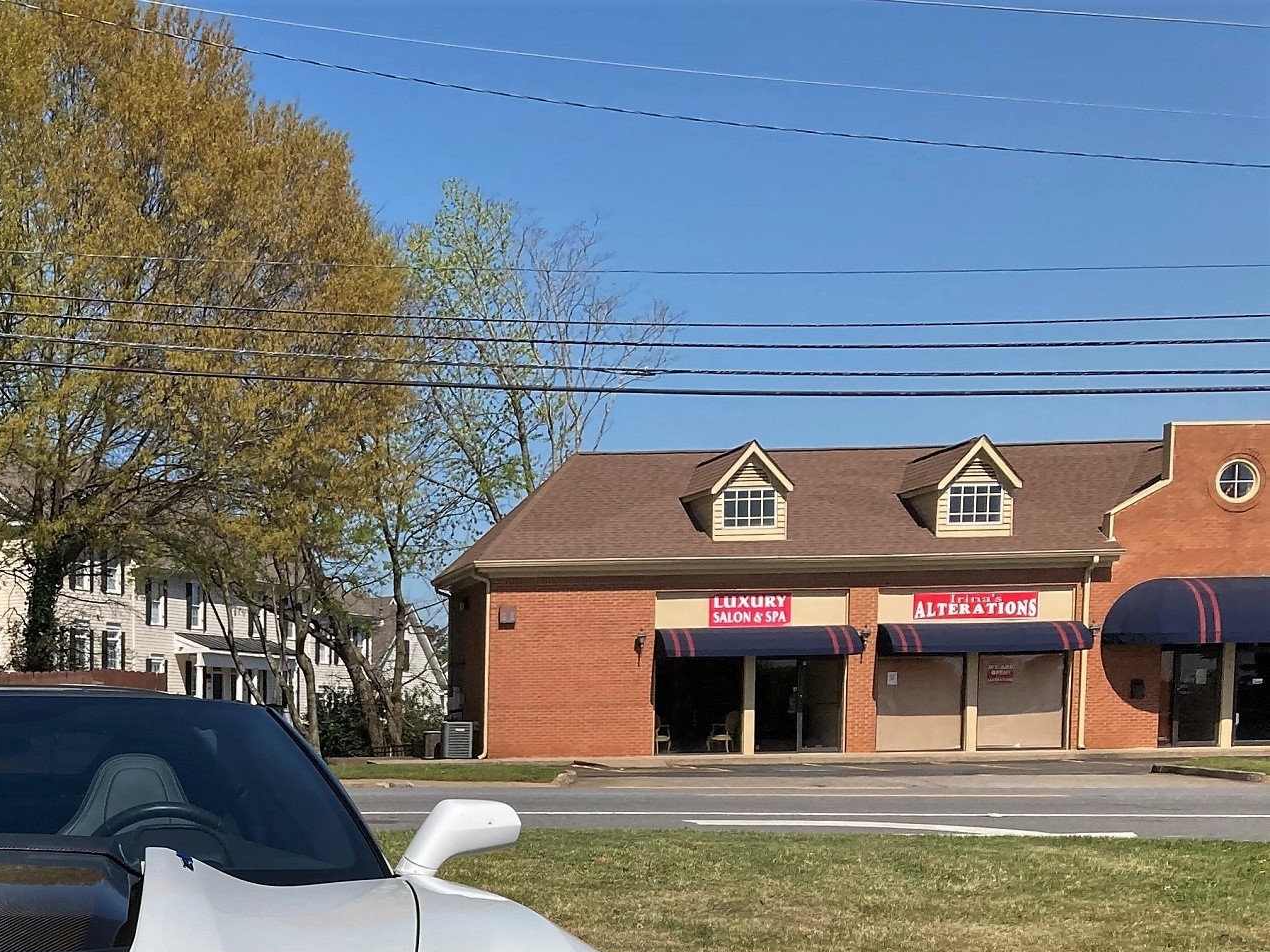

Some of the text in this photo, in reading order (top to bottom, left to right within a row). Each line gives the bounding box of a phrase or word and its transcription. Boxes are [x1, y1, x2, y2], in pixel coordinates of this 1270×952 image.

[713, 595, 787, 609] LUXURY
[950, 593, 1003, 604] Irina's
[914, 598, 1037, 619] ALTERATIONS
[713, 610, 787, 624] SALON & SPA
